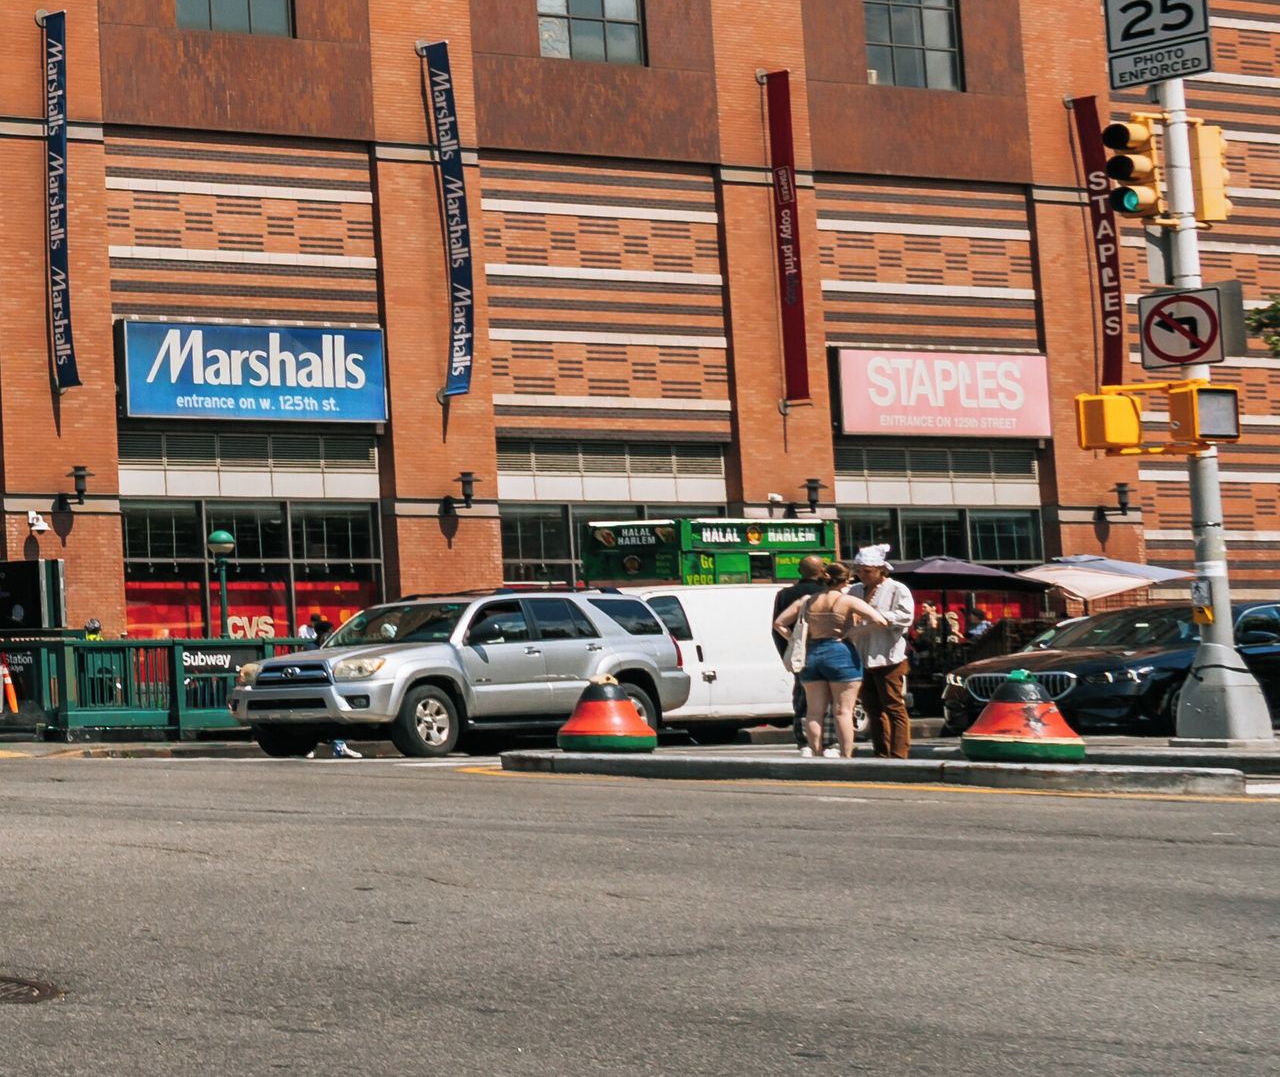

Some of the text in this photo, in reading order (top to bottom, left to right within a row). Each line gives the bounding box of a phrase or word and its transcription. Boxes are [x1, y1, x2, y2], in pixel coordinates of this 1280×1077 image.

[1119, 57, 1201, 83] ENFORCED
[1133, 48, 1185, 68] PHOTO
[47, 38, 63, 136] Marshalls
[430, 67, 454, 161] Marshalls
[48, 151, 64, 250] Marshalls
[444, 175, 465, 269] Marshalls
[780, 209, 792, 239] copy
[781, 244, 798, 275] print
[1089, 171, 1121, 336] STAPLES
[50, 266, 72, 366] Marshalls
[451, 282, 471, 377] Marshalls
[146, 328, 366, 390] Marshalls
[867, 356, 1025, 411] STAPLES
[176, 395, 341, 412] entrance on w. 125th st.
[880, 415, 934, 427] ENTRANCE
[936, 416, 951, 427] ON
[980, 417, 1017, 429] STREET
[617, 536, 656, 546] HARLEM
[622, 528, 651, 537] HALAL
[702, 527, 816, 542] HALAL HARLEM
[227, 616, 275, 639] CVS
[6, 654, 33, 664] Station
[182, 651, 231, 669] Subway
